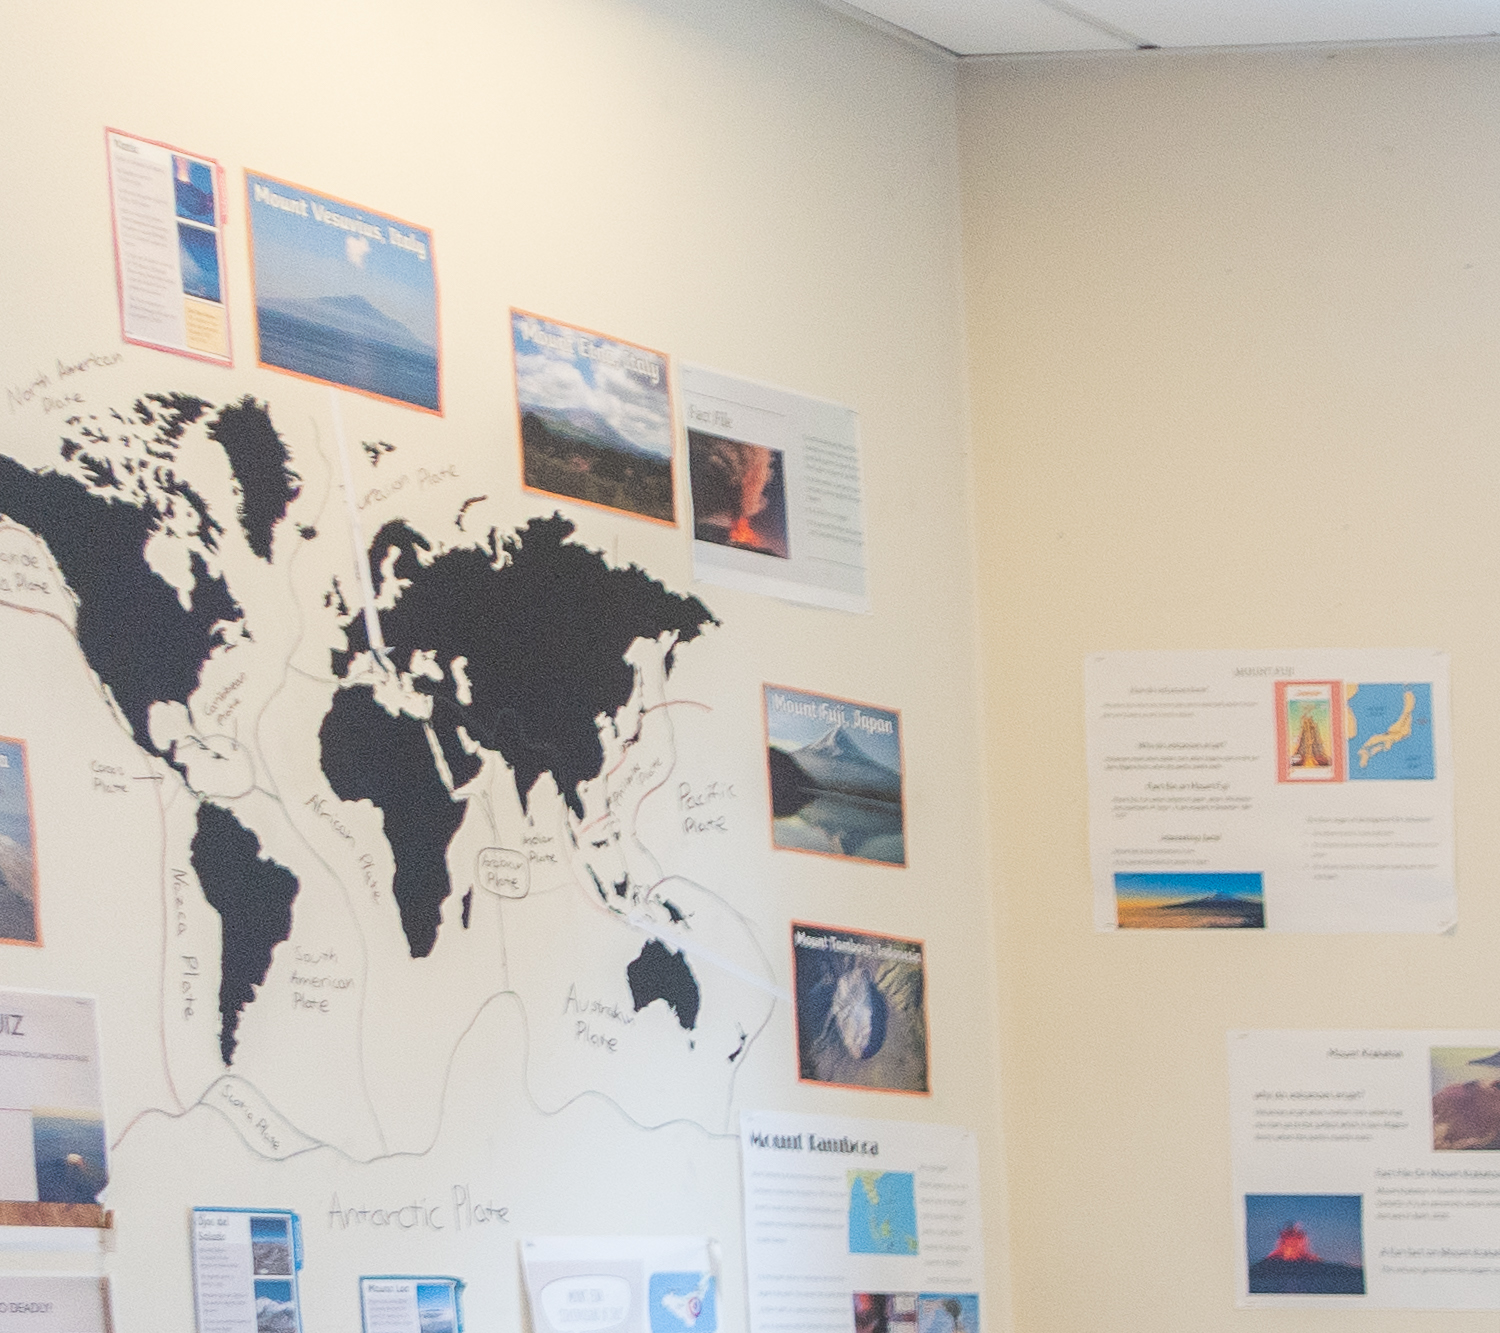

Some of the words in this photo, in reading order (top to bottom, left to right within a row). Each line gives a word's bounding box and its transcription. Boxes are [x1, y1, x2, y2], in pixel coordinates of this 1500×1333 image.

[254, 183, 308, 217] Mount
[311, 201, 386, 244] Vesuvius,
[388, 226, 426, 261] Italy
[521, 320, 575, 357] Mount
[774, 693, 818, 719] Mount
[818, 702, 850, 728] Fuji,
[852, 709, 894, 735] Japan
[182, 955, 200, 1021] Plate
[329, 1191, 444, 1230] Antarctic
[452, 1184, 510, 1230] Plate
